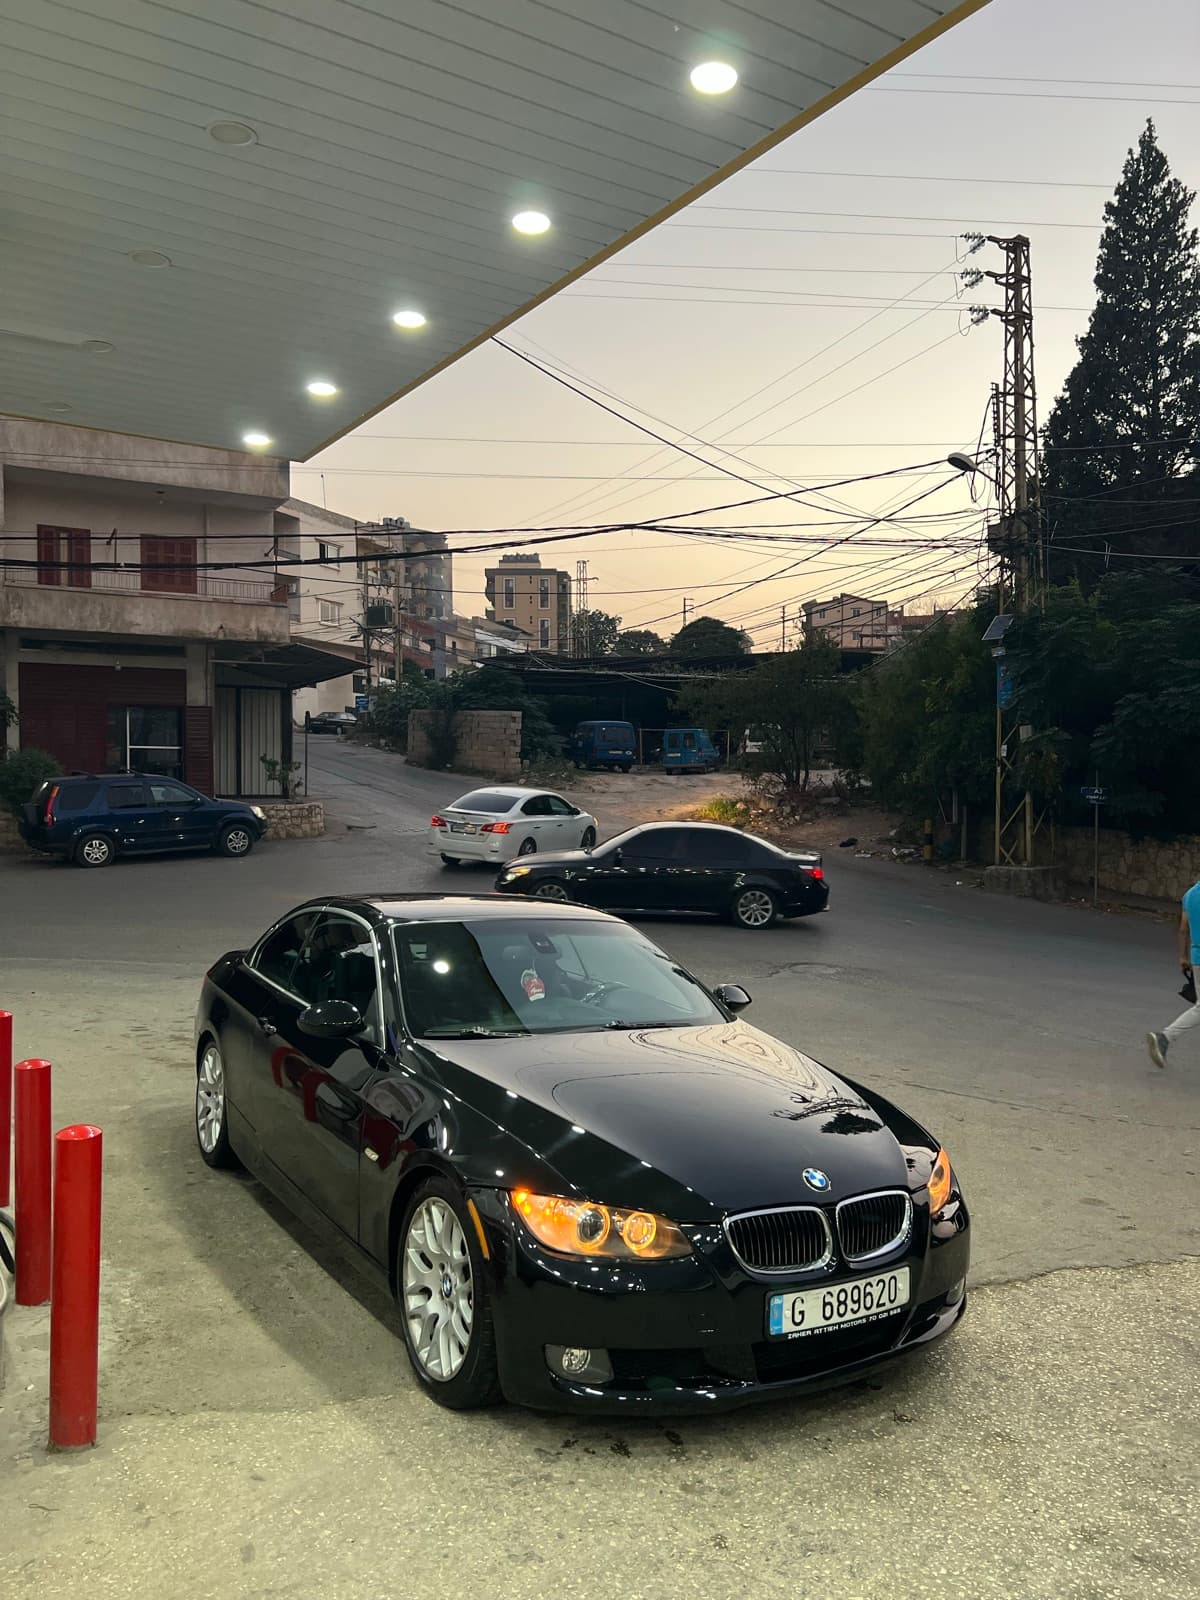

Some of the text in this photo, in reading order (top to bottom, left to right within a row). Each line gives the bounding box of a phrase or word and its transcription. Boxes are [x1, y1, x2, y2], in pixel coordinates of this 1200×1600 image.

[791, 1275, 898, 1327] G 689620
[840, 1317, 867, 1329] MOTORS
